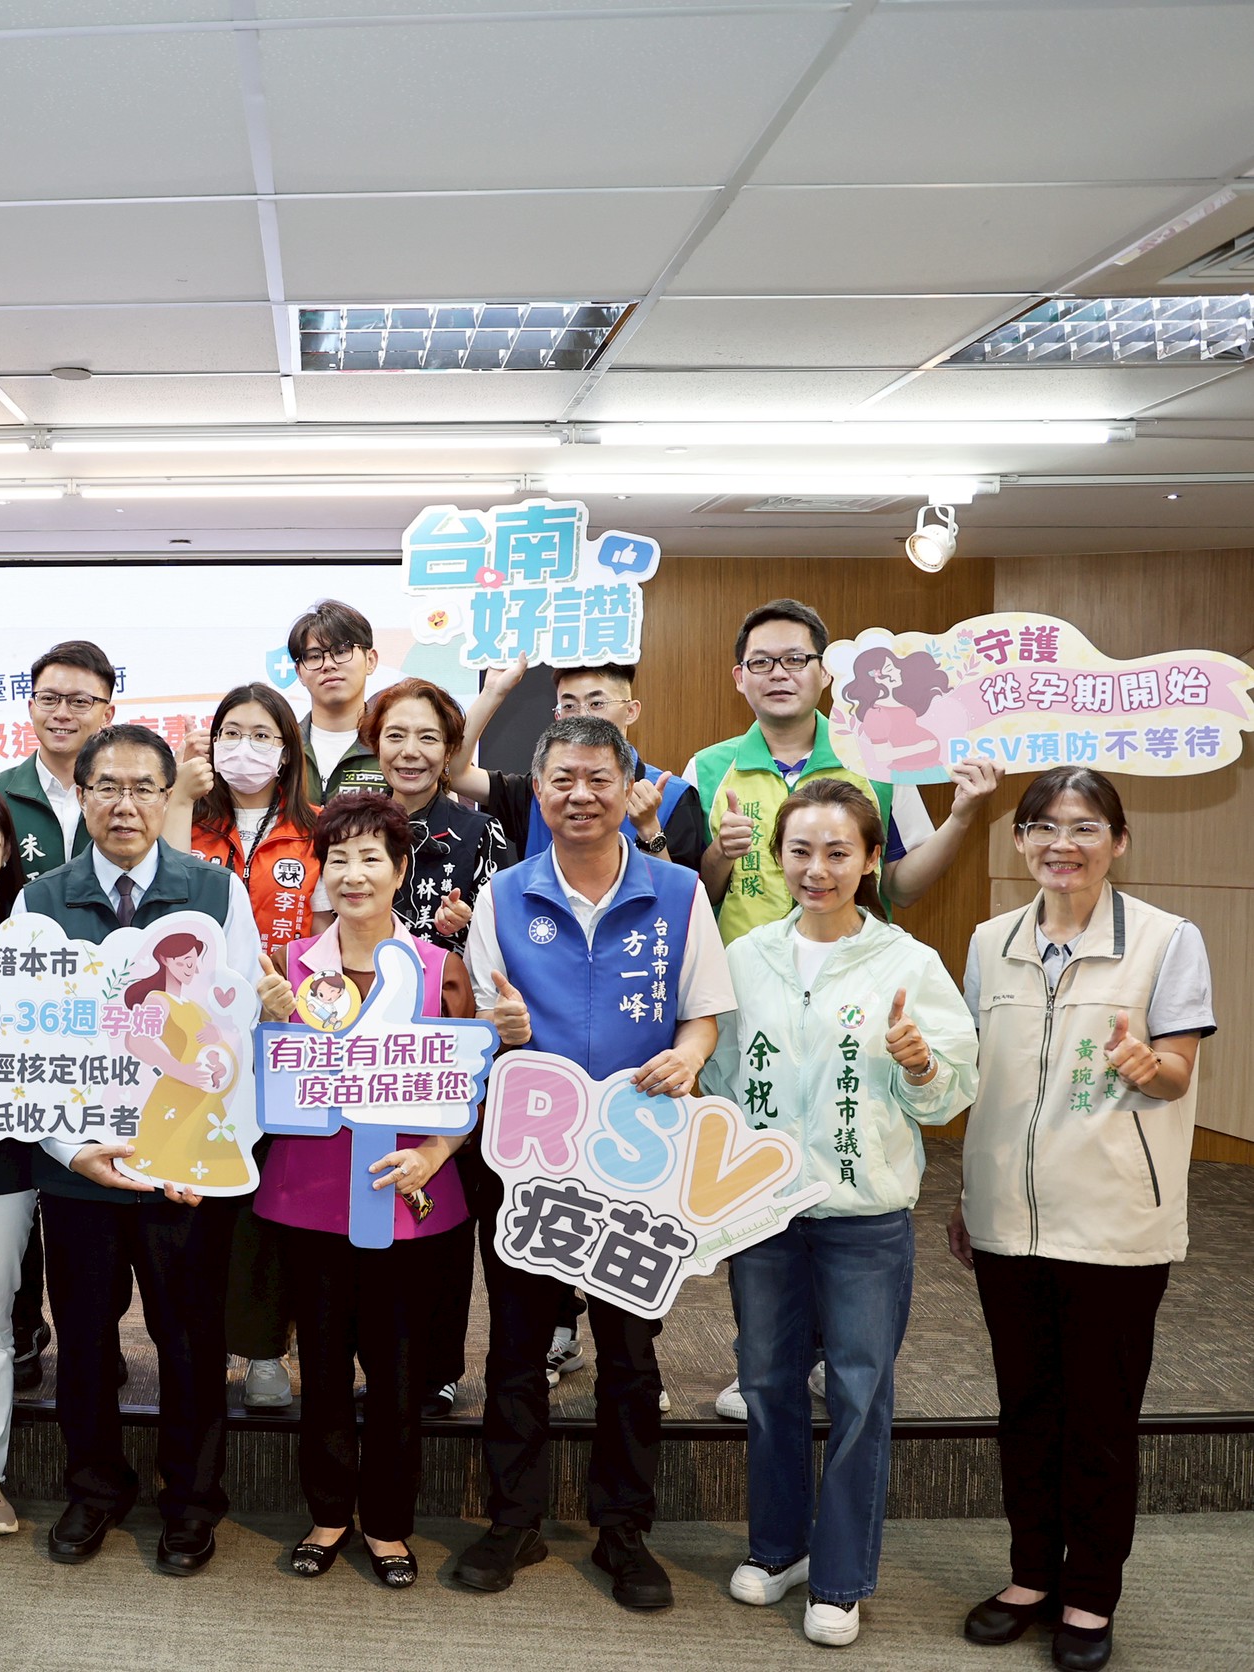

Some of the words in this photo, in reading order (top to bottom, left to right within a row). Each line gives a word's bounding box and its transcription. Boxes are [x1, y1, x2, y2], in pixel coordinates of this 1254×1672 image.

[408, 504, 577, 586] 台南
[467, 583, 630, 661] 好讚
[973, 625, 1060, 665] 守護
[981, 666, 1211, 715] 從孕期開始
[355, 772, 385, 782] DPP
[277, 861, 301, 883] 霖
[619, 930, 650, 1024] 方一峰
[651, 917, 670, 1024] 台南市議員
[269, 1032, 456, 1070] 有注有保庇
[297, 1070, 469, 1106] 疫苗保護您
[743, 1030, 781, 1130] 余祝
[492, 1060, 790, 1222] RSV
[833, 1034, 862, 1189] 台南市議員
[510, 1184, 689, 1304] 疫苗
